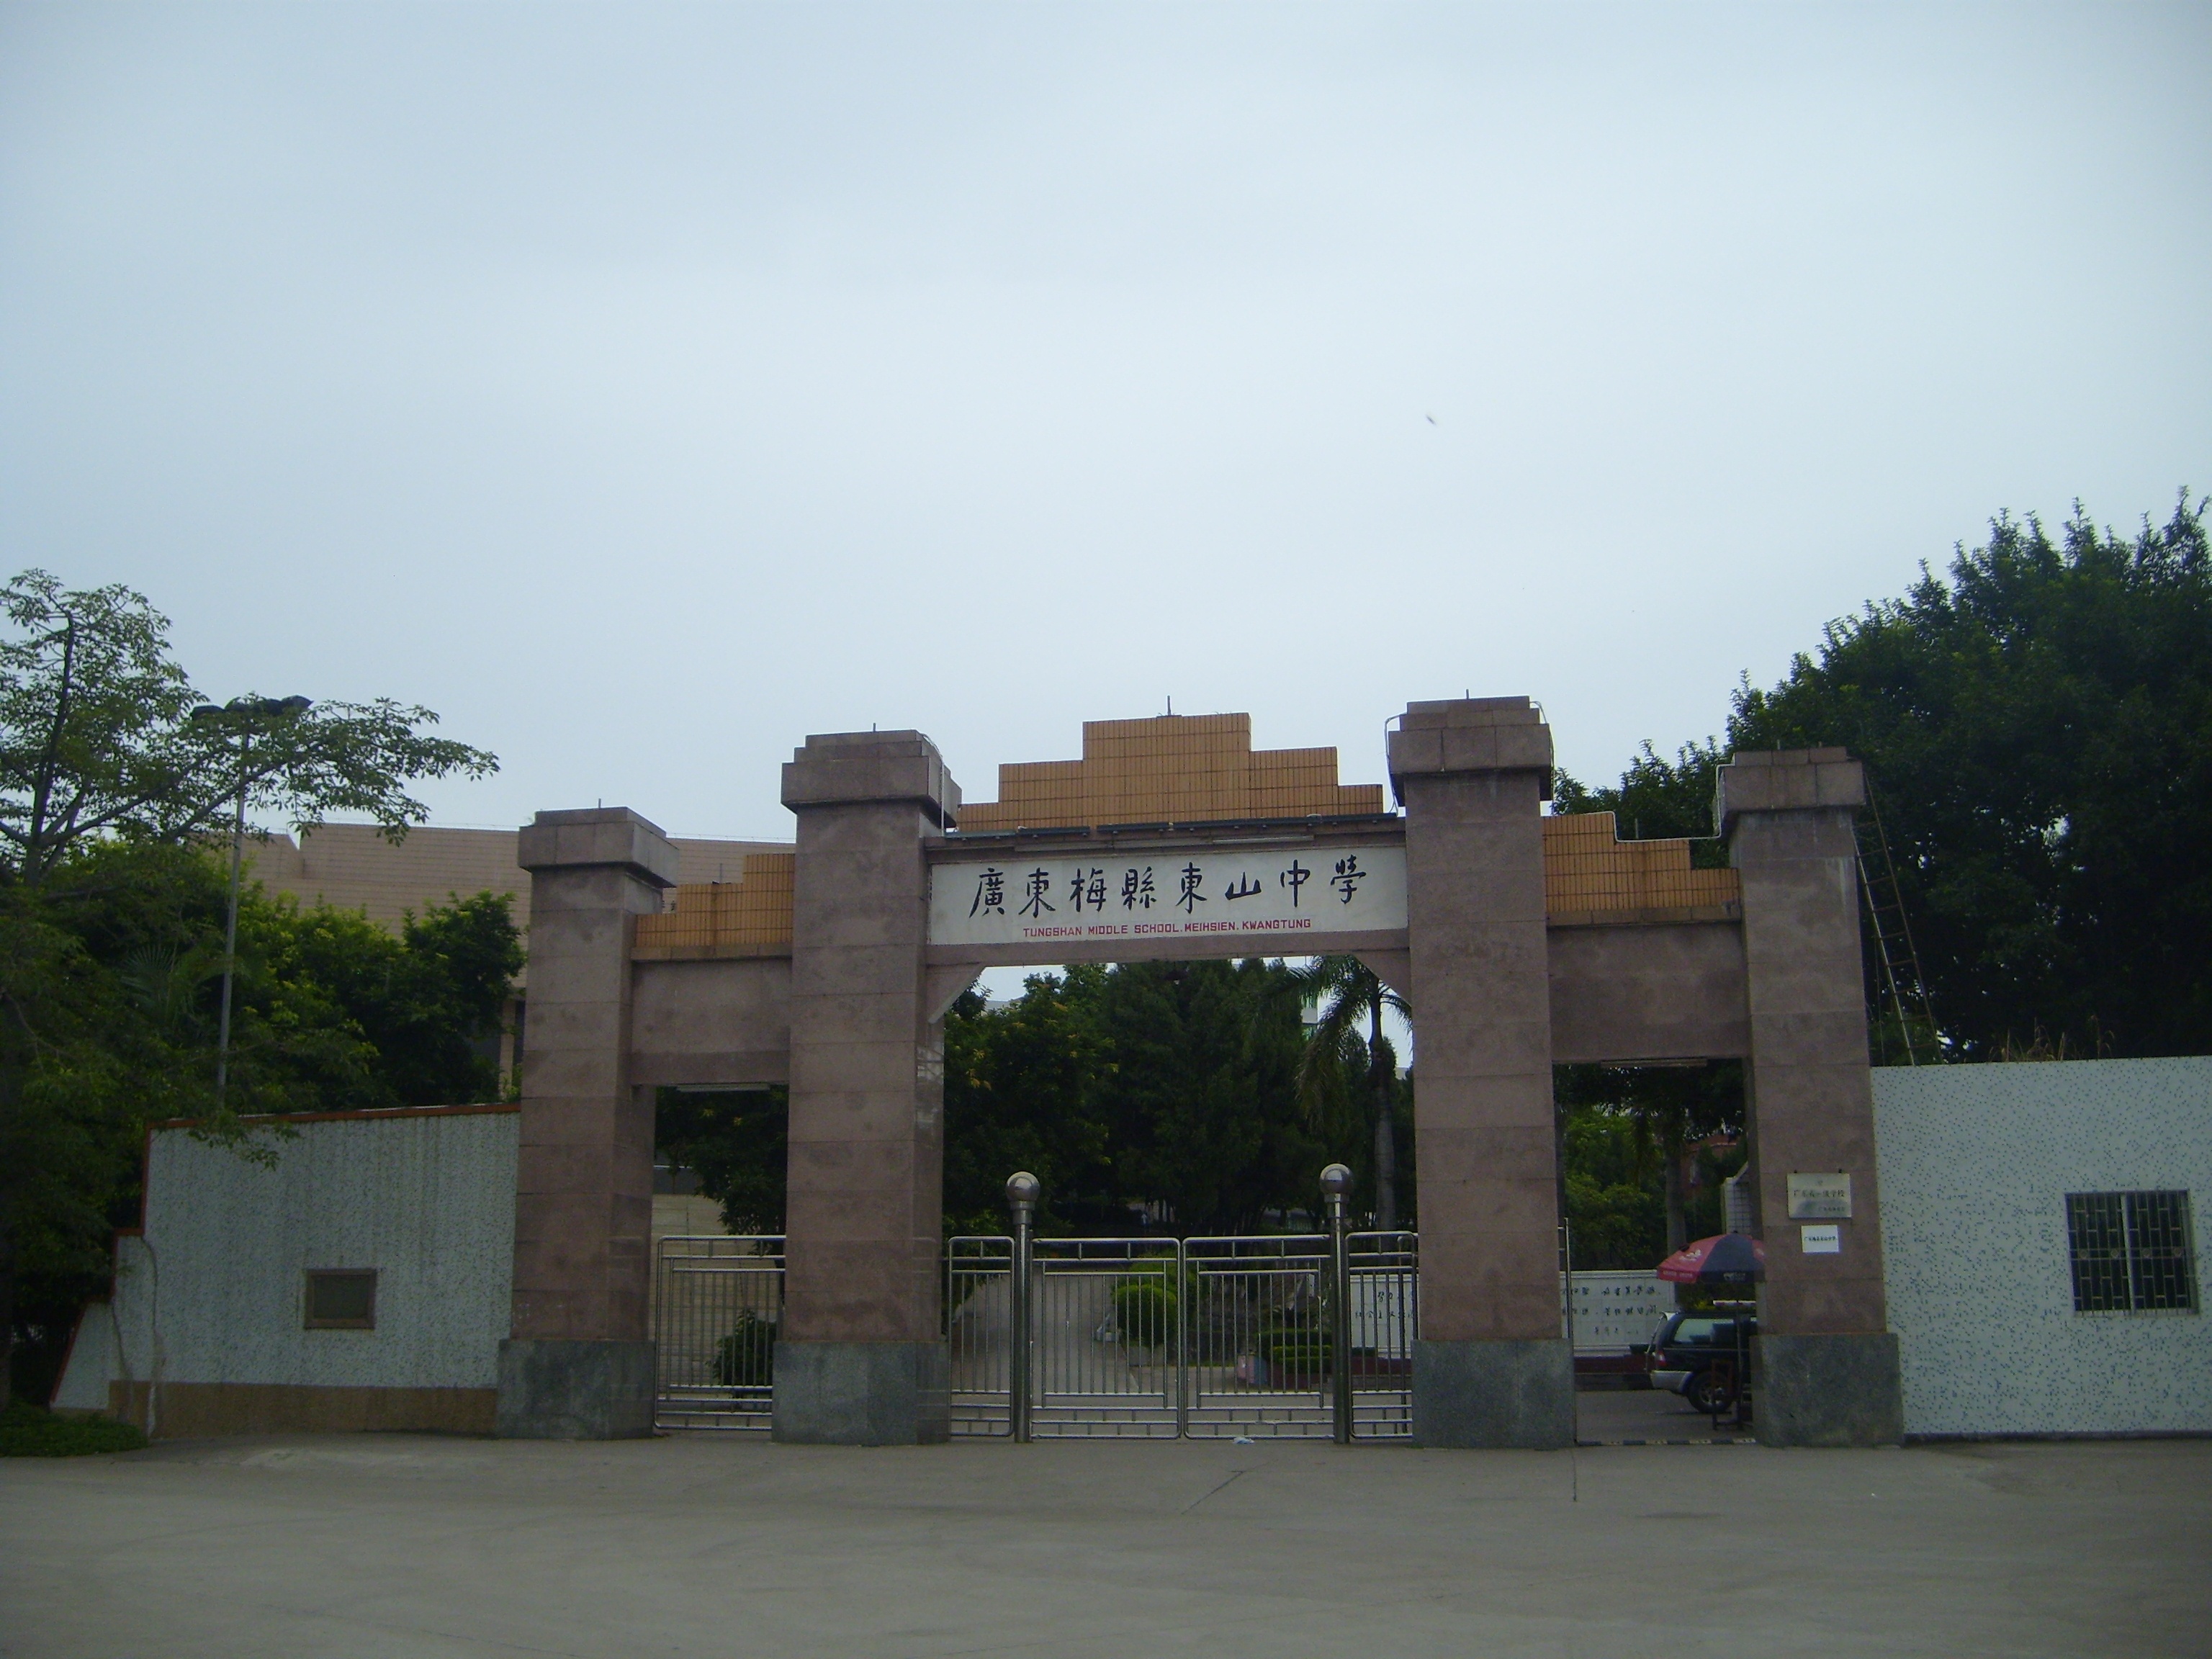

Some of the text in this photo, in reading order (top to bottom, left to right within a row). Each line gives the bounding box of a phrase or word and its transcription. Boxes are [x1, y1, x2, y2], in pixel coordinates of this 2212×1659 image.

[968, 854, 1367, 919] 廣東梅縣東山中學
[1022, 927, 1082, 938] TUNGSHAN
[1088, 925, 1128, 935] MIDDLE
[1241, 919, 1311, 930] KWANGTUNG
